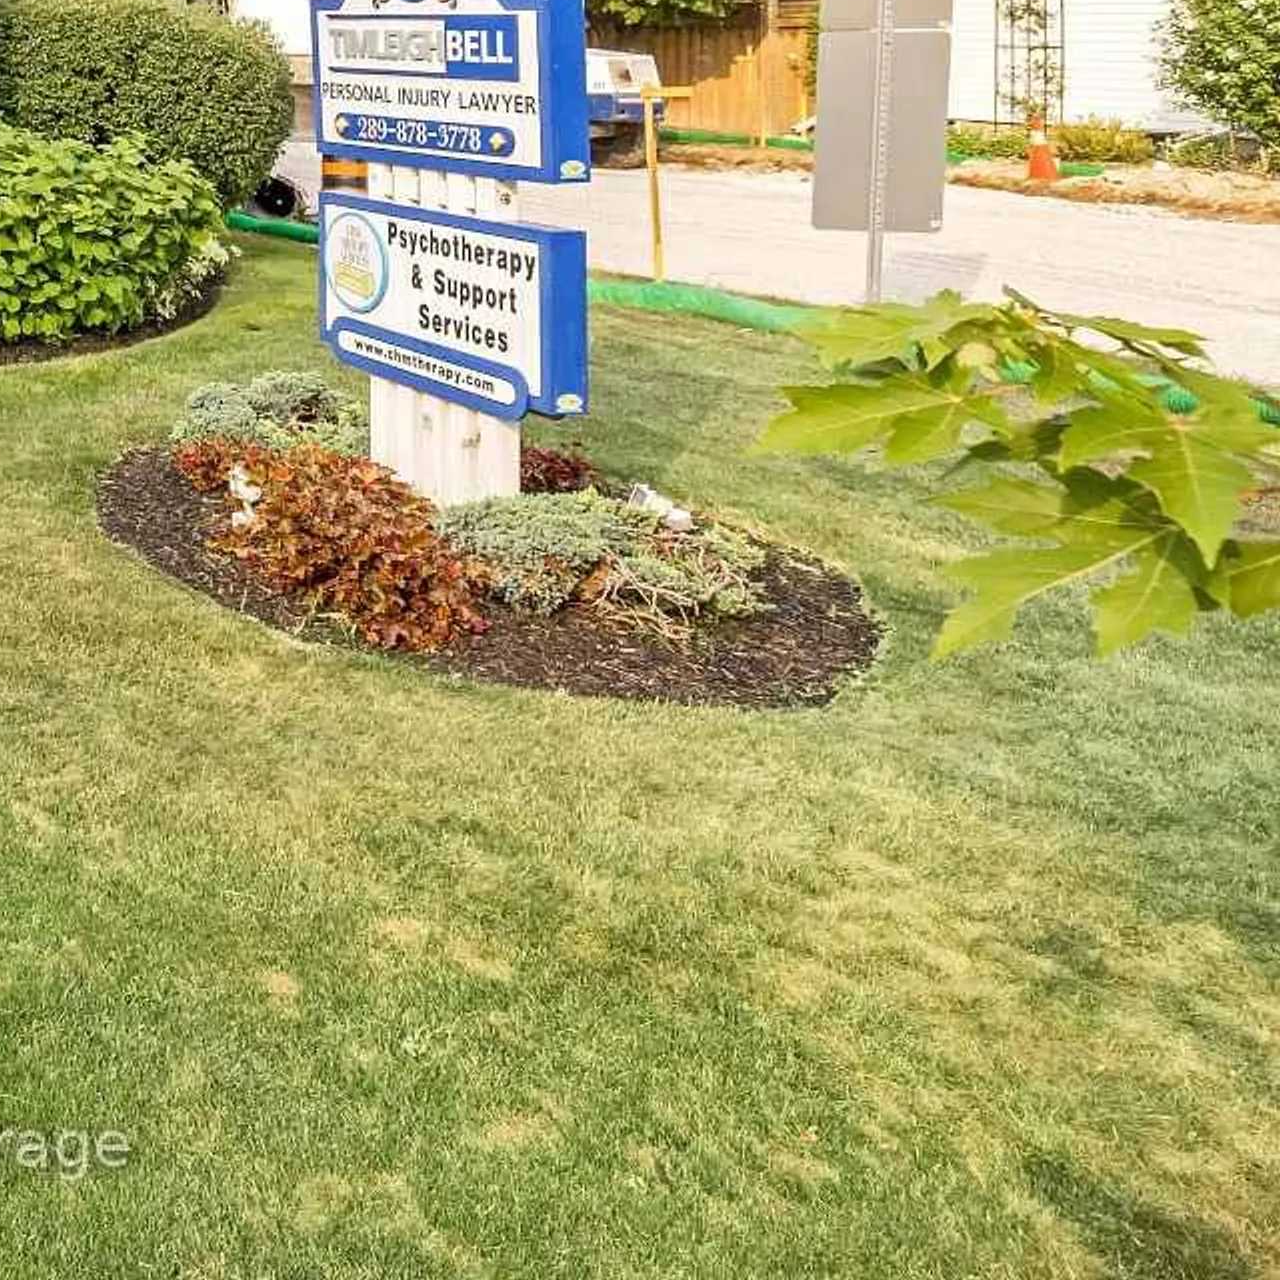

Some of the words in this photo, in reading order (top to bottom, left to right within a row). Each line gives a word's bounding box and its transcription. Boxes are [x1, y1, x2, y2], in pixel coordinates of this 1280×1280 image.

[446, 30, 513, 64] BELL
[322, 81, 392, 104] PERSONAL
[397, 88, 451, 110] INJURY
[458, 93, 536, 115] LAWYER
[357, 117, 481, 151] 289-878-3778
[387, 222, 536, 281] Psychotherapy
[411, 263, 424, 290] &
[434, 270, 517, 314] Support
[418, 304, 509, 353] Services
[354, 338, 495, 393] www.chmtherapy.com
